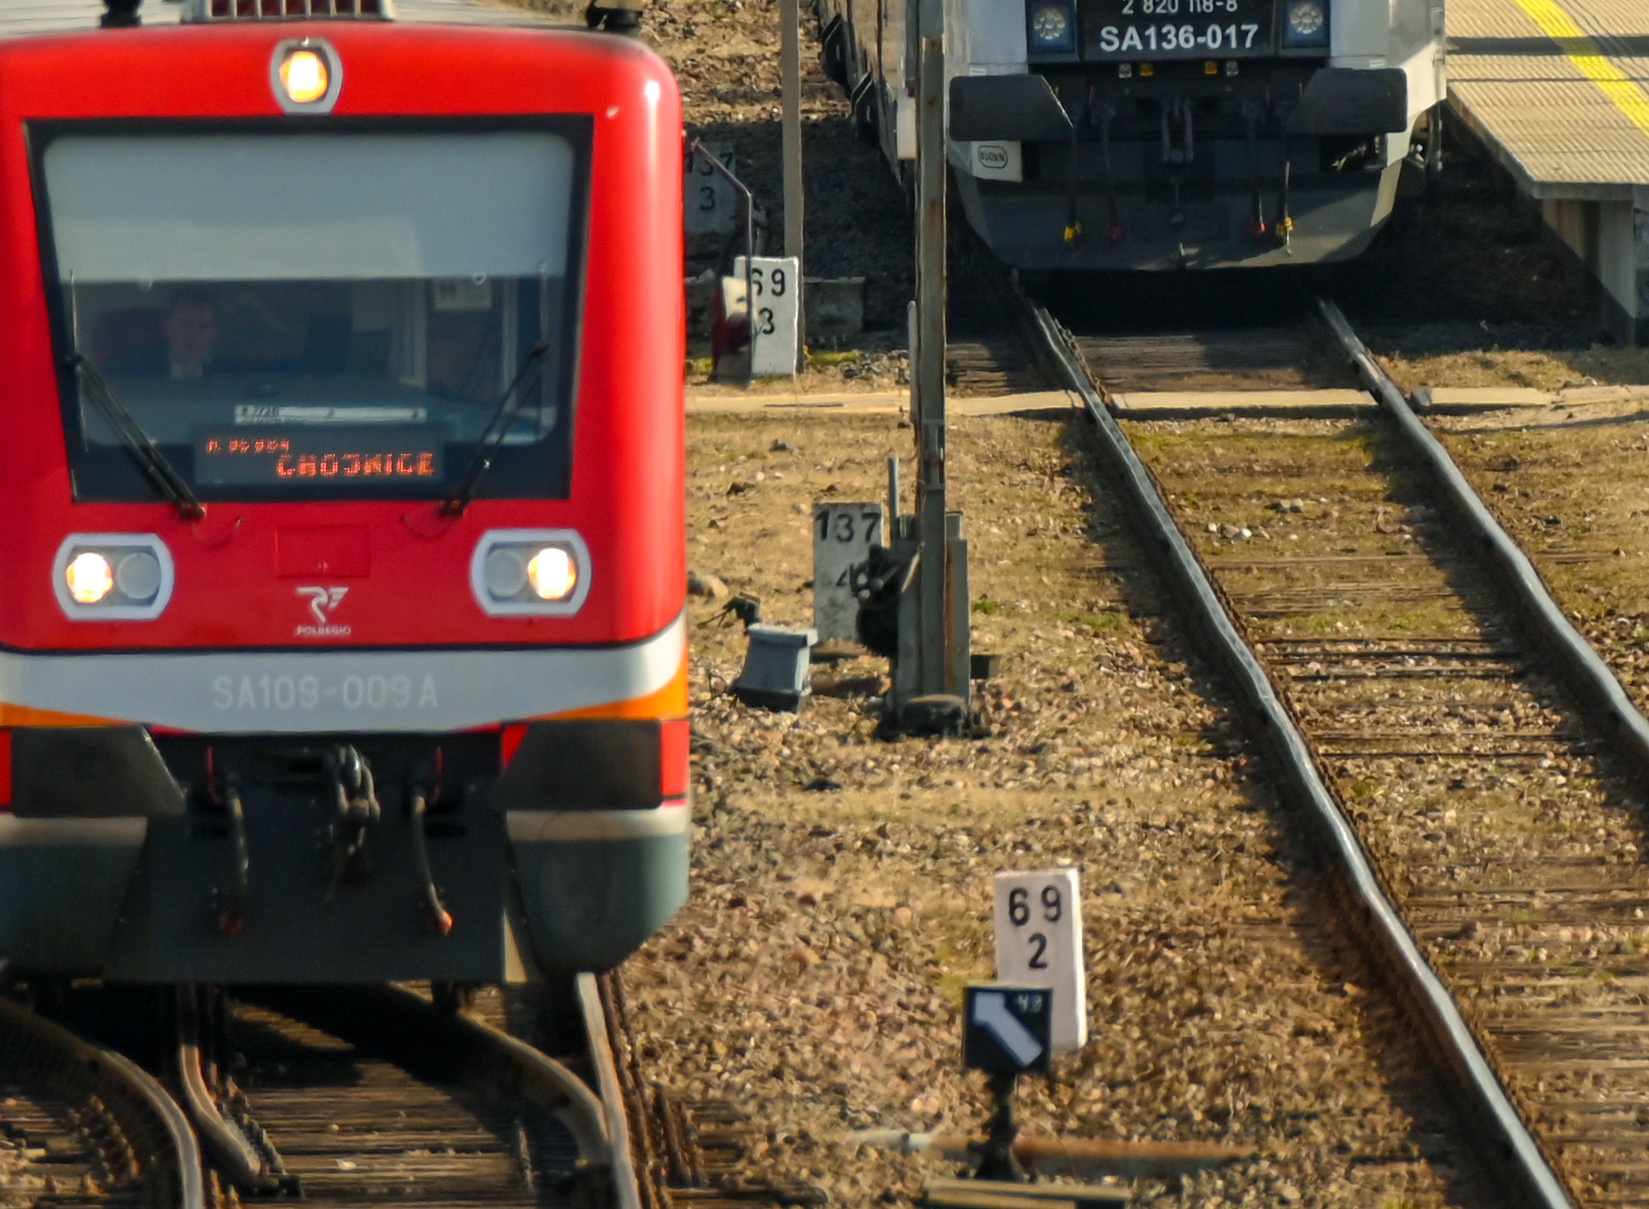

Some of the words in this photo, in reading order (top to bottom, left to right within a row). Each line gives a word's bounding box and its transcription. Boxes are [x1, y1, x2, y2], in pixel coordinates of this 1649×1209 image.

[1100, 24, 1259, 52] SA136-017
[700, 187, 715, 211] 3
[759, 307, 775, 335] 3
[816, 510, 880, 542] 137
[1028, 933, 1048, 969] 2
